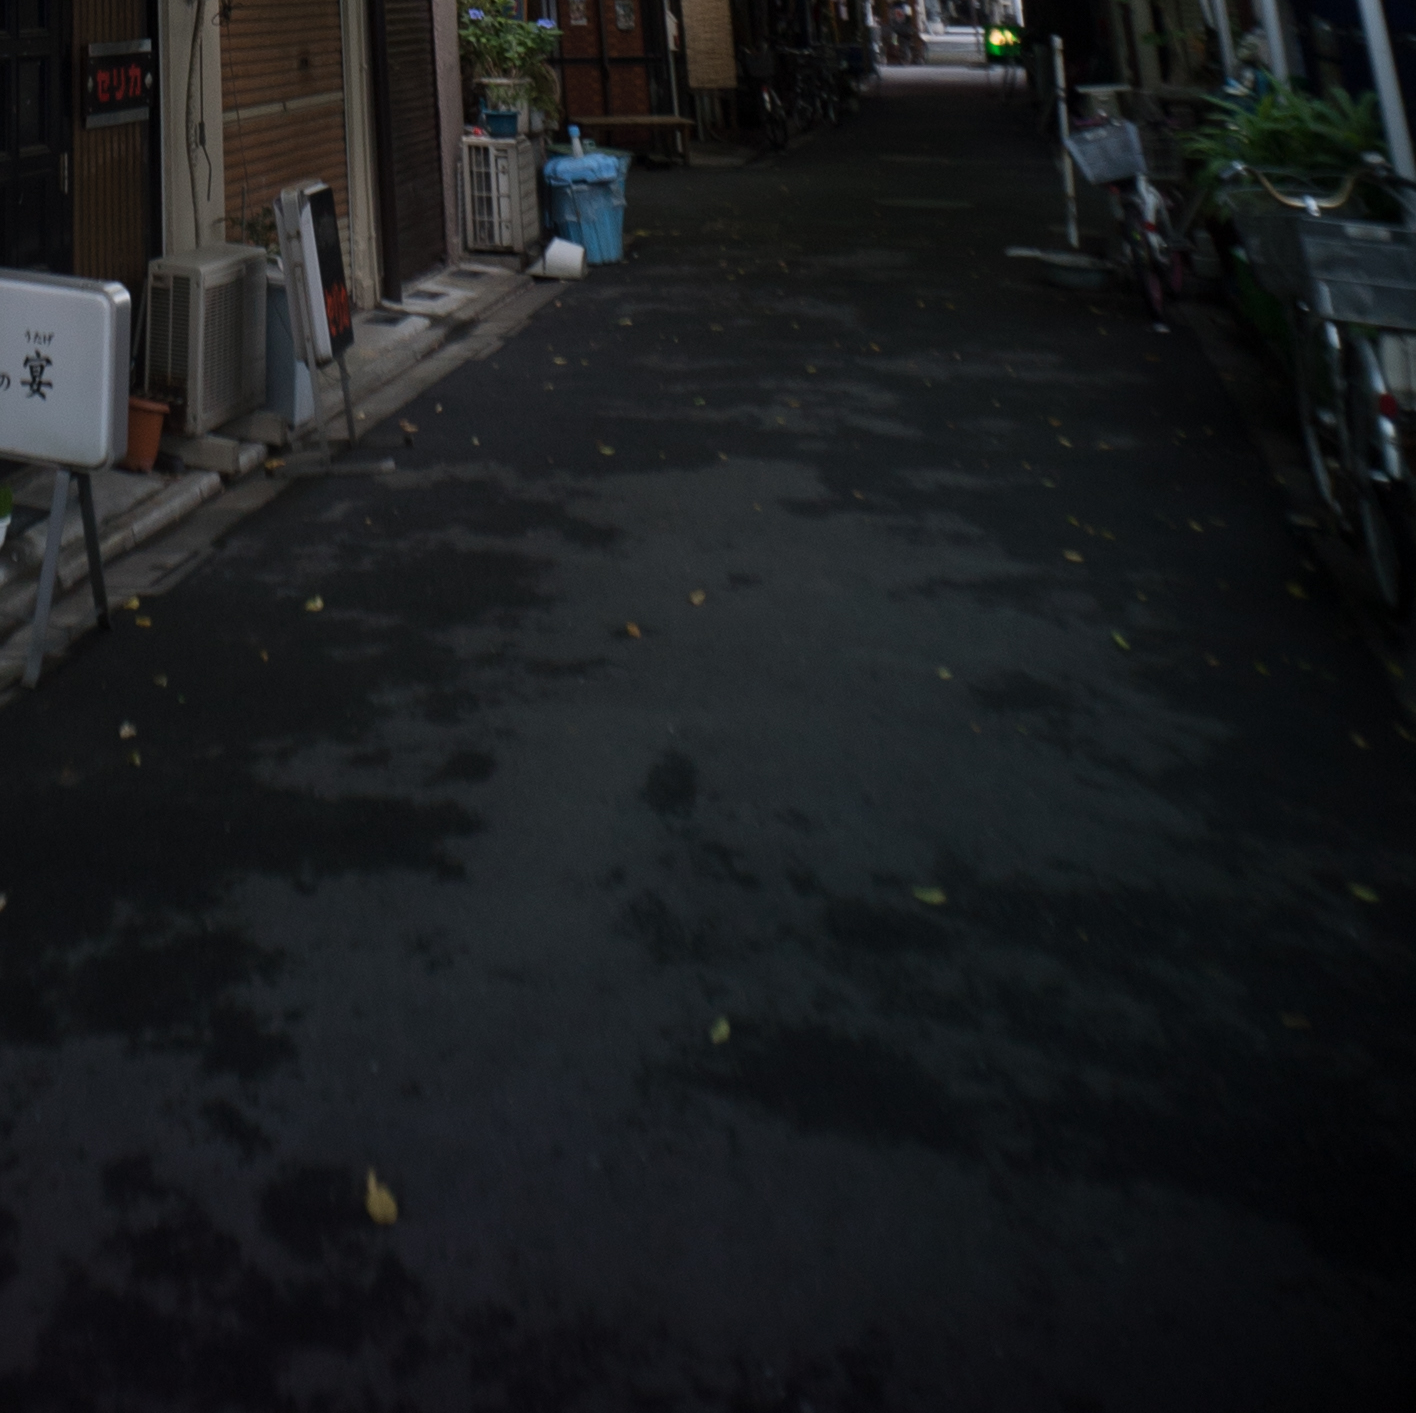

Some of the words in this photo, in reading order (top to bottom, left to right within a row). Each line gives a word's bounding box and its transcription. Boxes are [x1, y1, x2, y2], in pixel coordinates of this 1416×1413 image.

[96, 62, 142, 104] セリカ
[24, 328, 55, 347] うたげ
